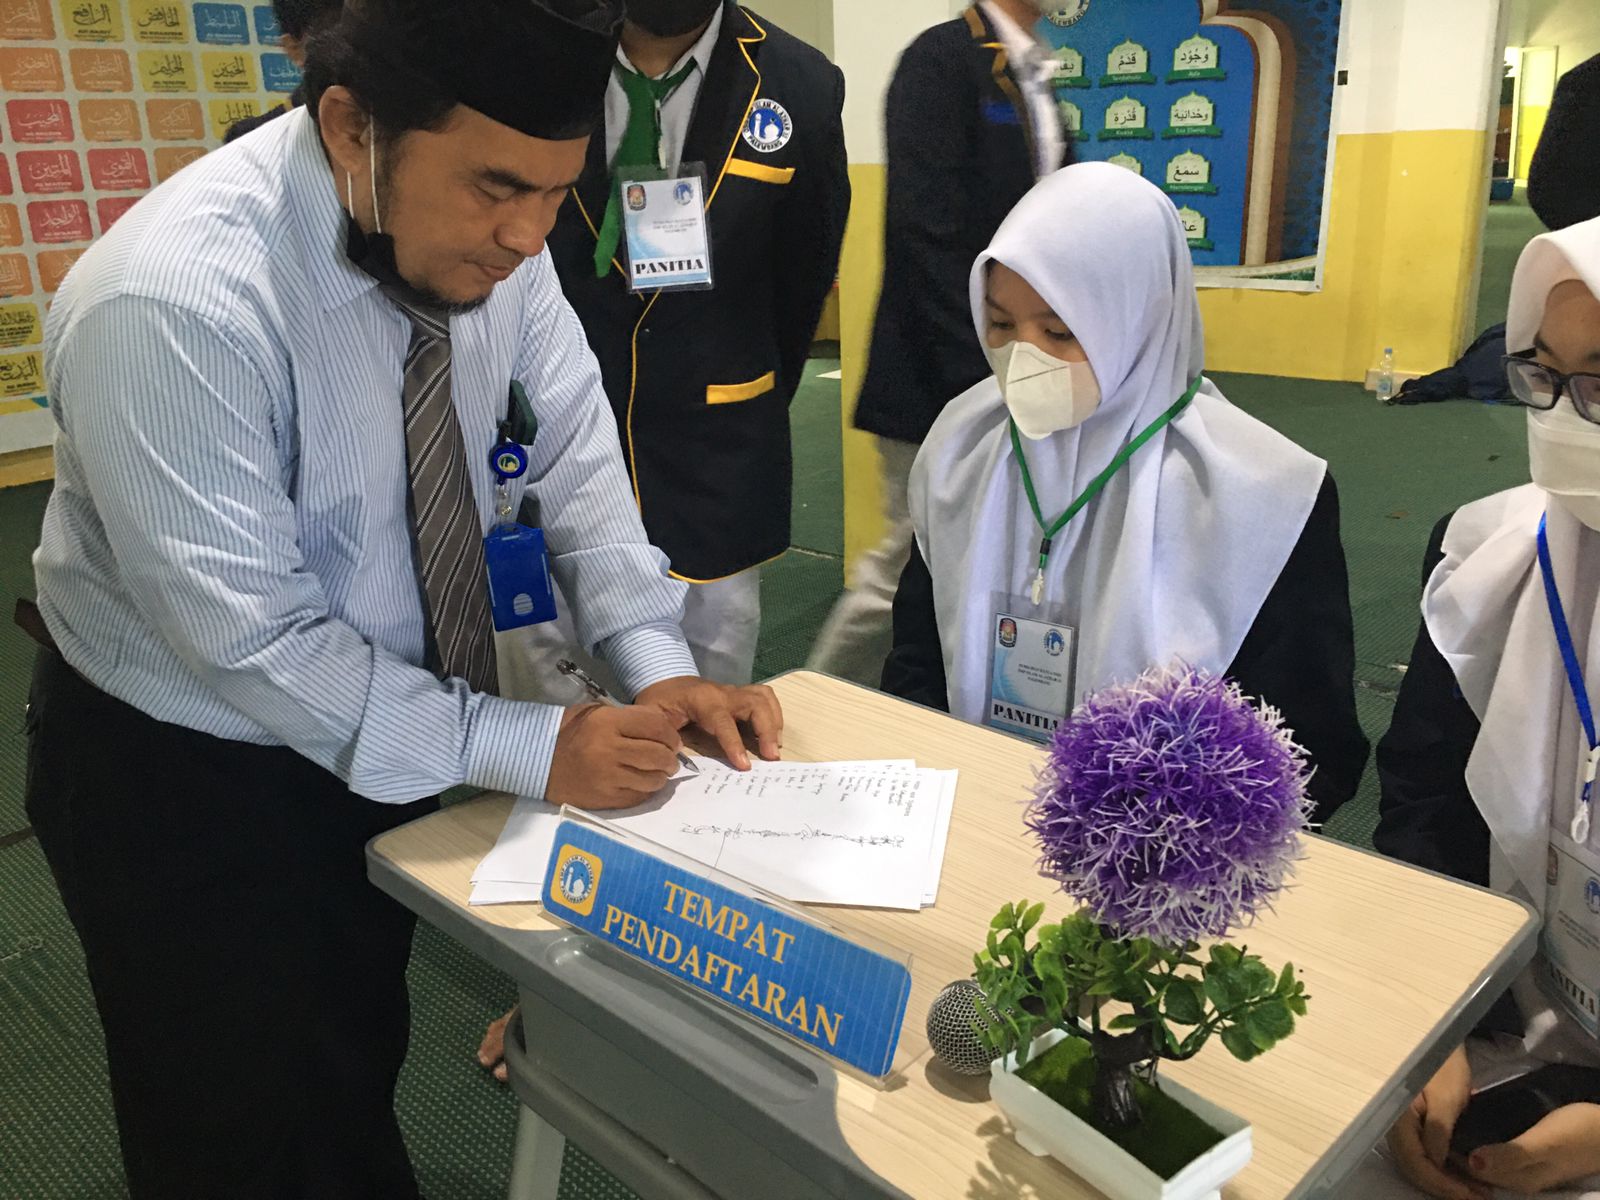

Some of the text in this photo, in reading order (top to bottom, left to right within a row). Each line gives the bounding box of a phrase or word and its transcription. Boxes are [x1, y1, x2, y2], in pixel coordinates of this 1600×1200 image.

[634, 258, 704, 276] PANITIA
[663, 880, 796, 965] TEMPAT
[601, 903, 844, 1047] PENDAFTARAN
